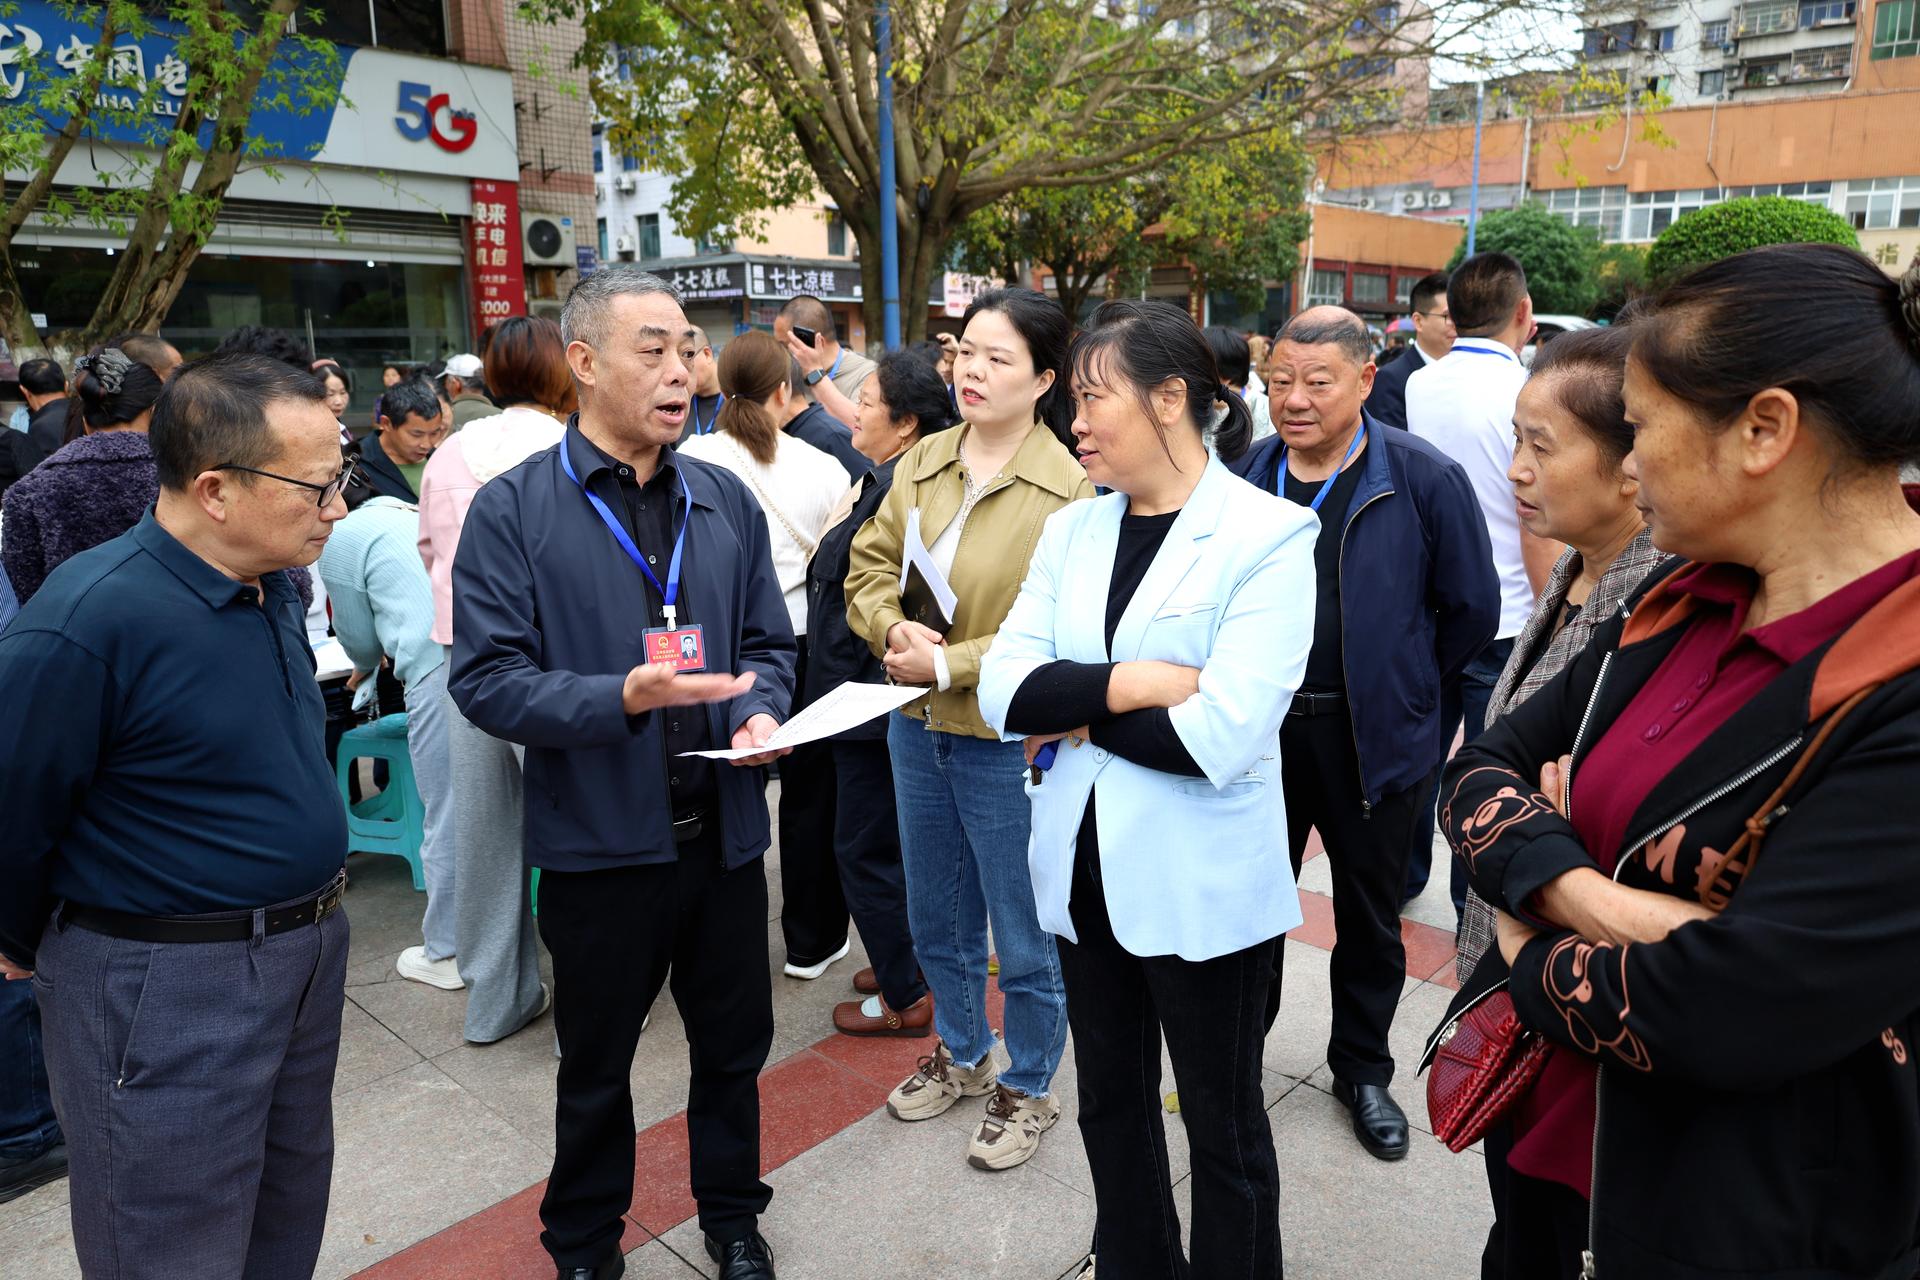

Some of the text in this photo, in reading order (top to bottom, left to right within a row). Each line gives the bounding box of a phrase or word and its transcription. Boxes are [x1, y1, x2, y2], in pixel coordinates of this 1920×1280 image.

[394, 80, 478, 154] 5G
[769, 267, 836, 292] 七七凉糕
